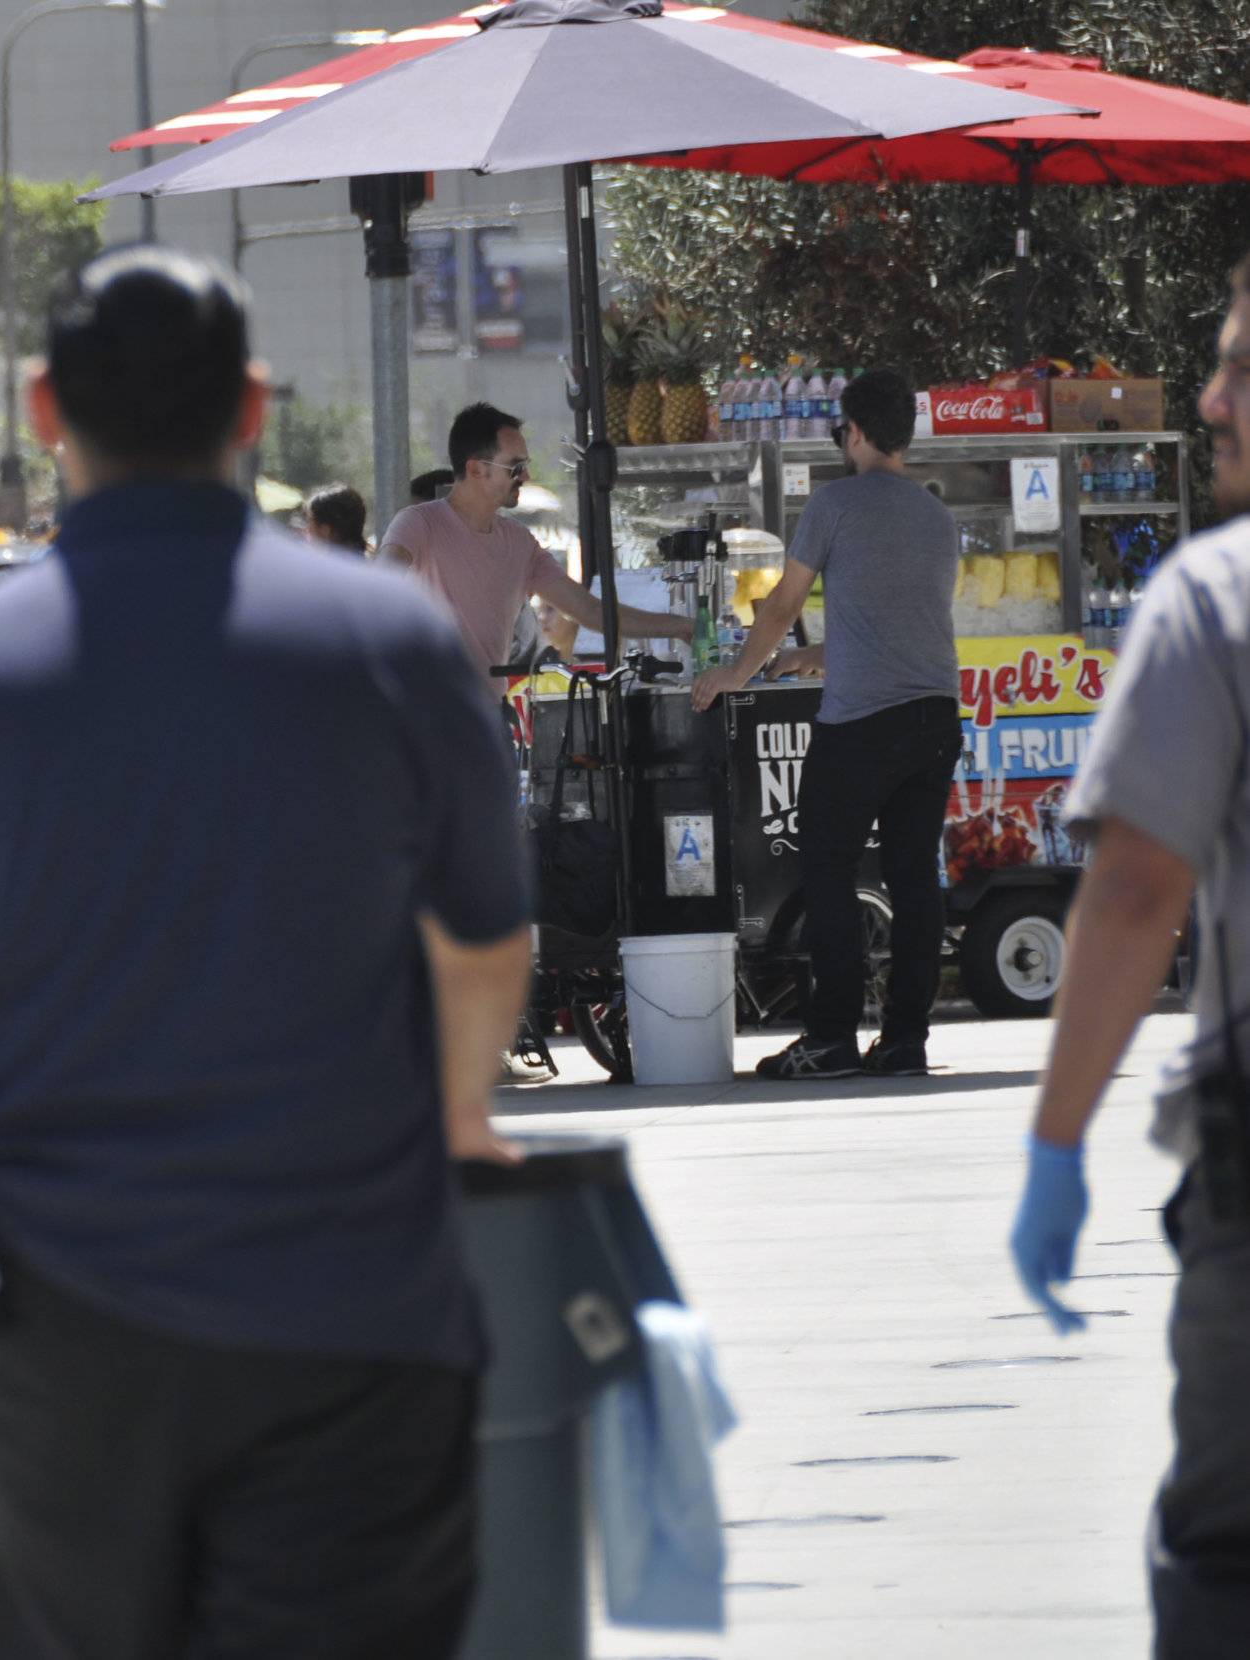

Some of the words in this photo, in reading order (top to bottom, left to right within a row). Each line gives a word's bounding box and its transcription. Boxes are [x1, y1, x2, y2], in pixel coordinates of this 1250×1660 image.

[936, 396, 1004, 422] Coca-Cola
[1025, 469, 1050, 500] A
[756, 722, 812, 759] COLD
[675, 828, 701, 861] A
